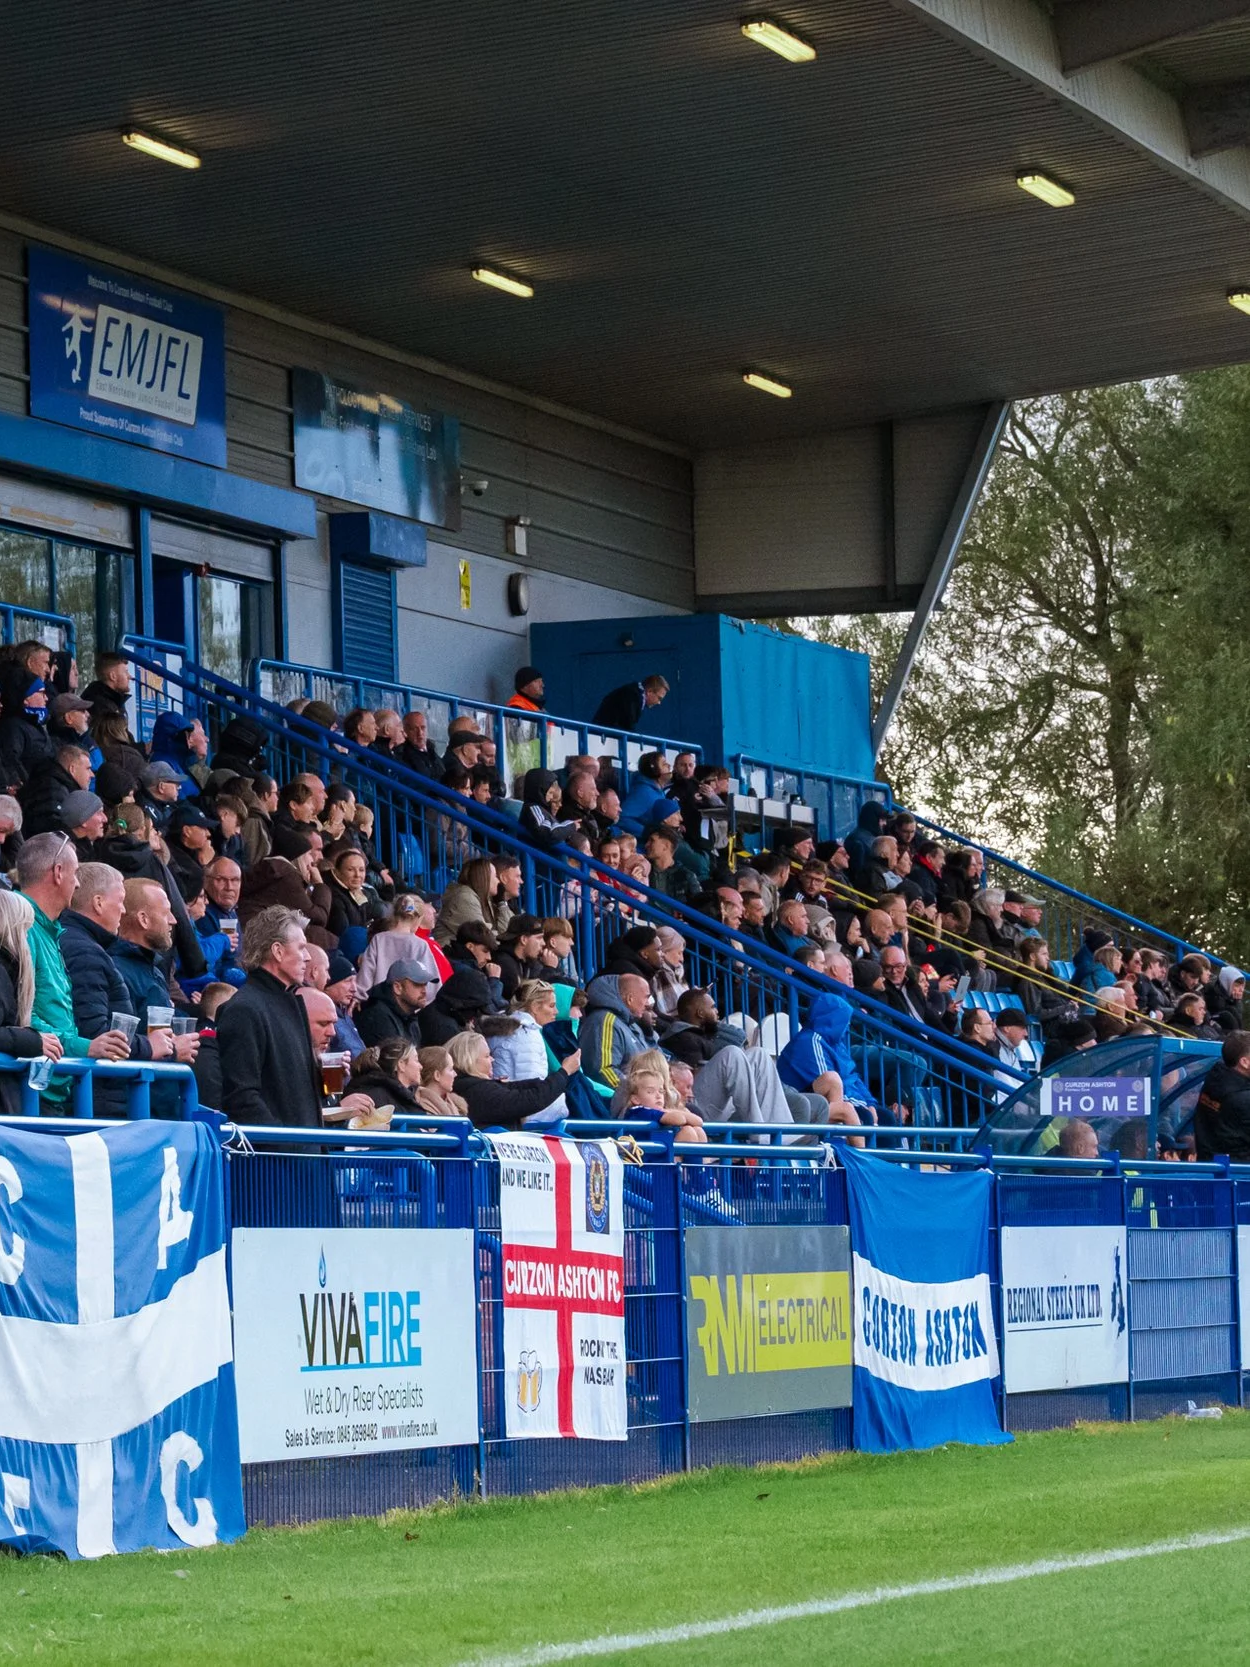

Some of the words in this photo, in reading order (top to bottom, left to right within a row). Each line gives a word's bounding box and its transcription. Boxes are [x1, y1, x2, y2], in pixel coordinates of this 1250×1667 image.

[98, 316, 191, 400] EMJFL
[1058, 1095, 1138, 1112] HOME
[501, 1167, 515, 1187] AND
[516, 1169, 526, 1188] WE
[528, 1171, 542, 1190] LIKE
[157, 1146, 194, 1270] A
[505, 1259, 555, 1296] CURZON
[558, 1264, 605, 1302] ASHTON
[607, 1269, 621, 1304] FC
[1007, 1286, 1046, 1324] REGIONAL
[1047, 1285, 1073, 1321] STEELS
[1074, 1284, 1086, 1319] UK
[299, 1290, 422, 1368] VIVAFIRE
[758, 1296, 847, 1346] ELECTRICAL
[925, 1300, 988, 1367] ASHTON
[304, 1386, 324, 1416] Wet
[326, 1387, 333, 1413] &
[335, 1385, 351, 1418] Dry
[353, 1384, 376, 1411] Riser
[377, 1382, 424, 1416] Specialists
[285, 1428, 303, 1448] Sales
[311, 1426, 336, 1446] Service:
[336, 1425, 351, 1443] 0845
[351, 1424, 378, 1443] 2698482
[381, 1419, 439, 1440] www.vivafire.co.uk
[159, 1430, 218, 1548] C
